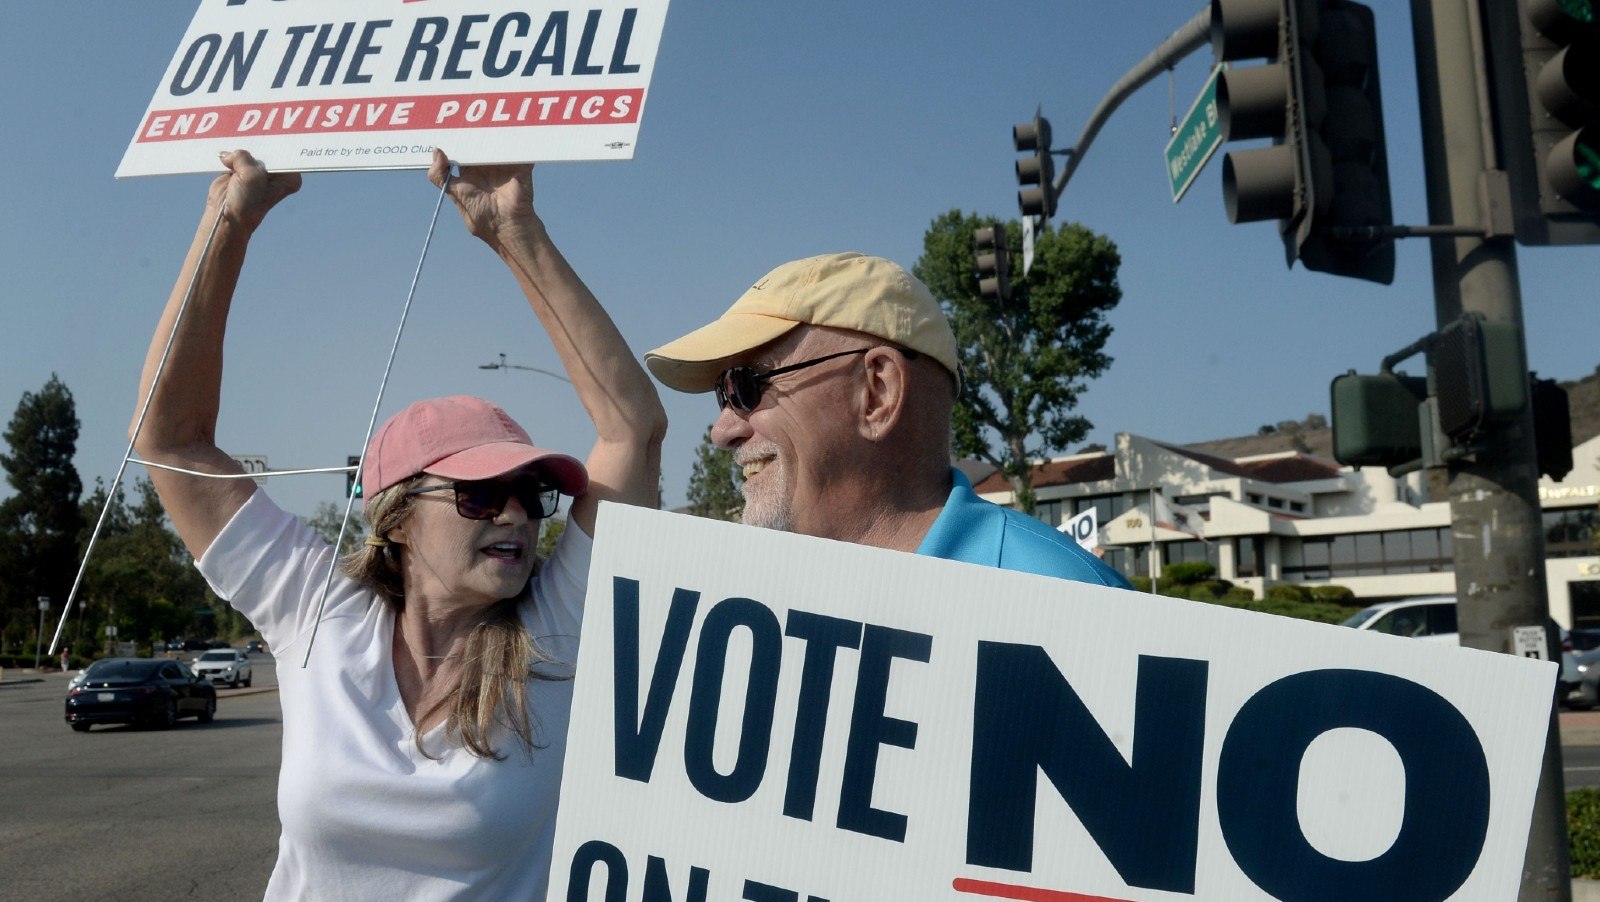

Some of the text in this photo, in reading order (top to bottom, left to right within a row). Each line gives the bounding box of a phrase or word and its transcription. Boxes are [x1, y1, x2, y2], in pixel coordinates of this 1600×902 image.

[169, 8, 641, 97] ON THE RECALL
[145, 94, 633, 138] END DIVISIVE POLITICS
[299, 144, 434, 159] Paid for by the GOOD Club
[1171, 121, 1207, 181] Westlake
[613, 577, 1490, 902] VOTE NO
